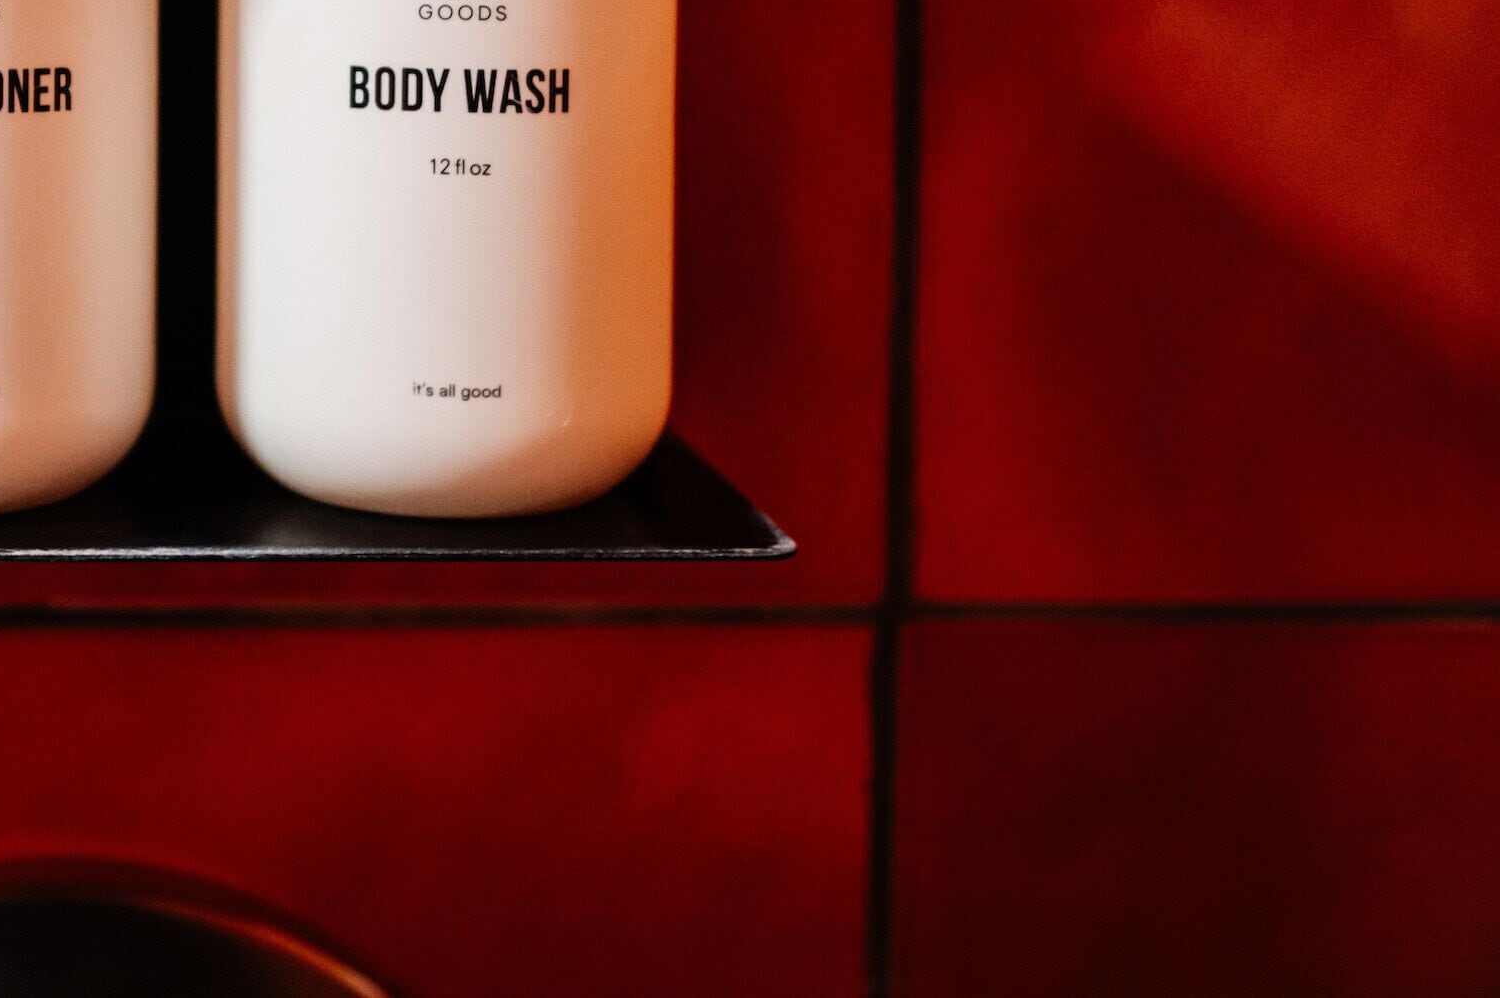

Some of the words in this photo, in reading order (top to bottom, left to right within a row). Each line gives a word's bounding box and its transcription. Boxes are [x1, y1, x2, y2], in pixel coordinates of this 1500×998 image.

[418, 2, 508, 22] GOODS
[348, 64, 451, 113] BODY
[463, 68, 570, 115] WASH
[430, 157, 451, 176] 12
[454, 158, 466, 175] fl
[469, 163, 492, 177] oz
[438, 383, 456, 398] all
[460, 384, 502, 402] good
